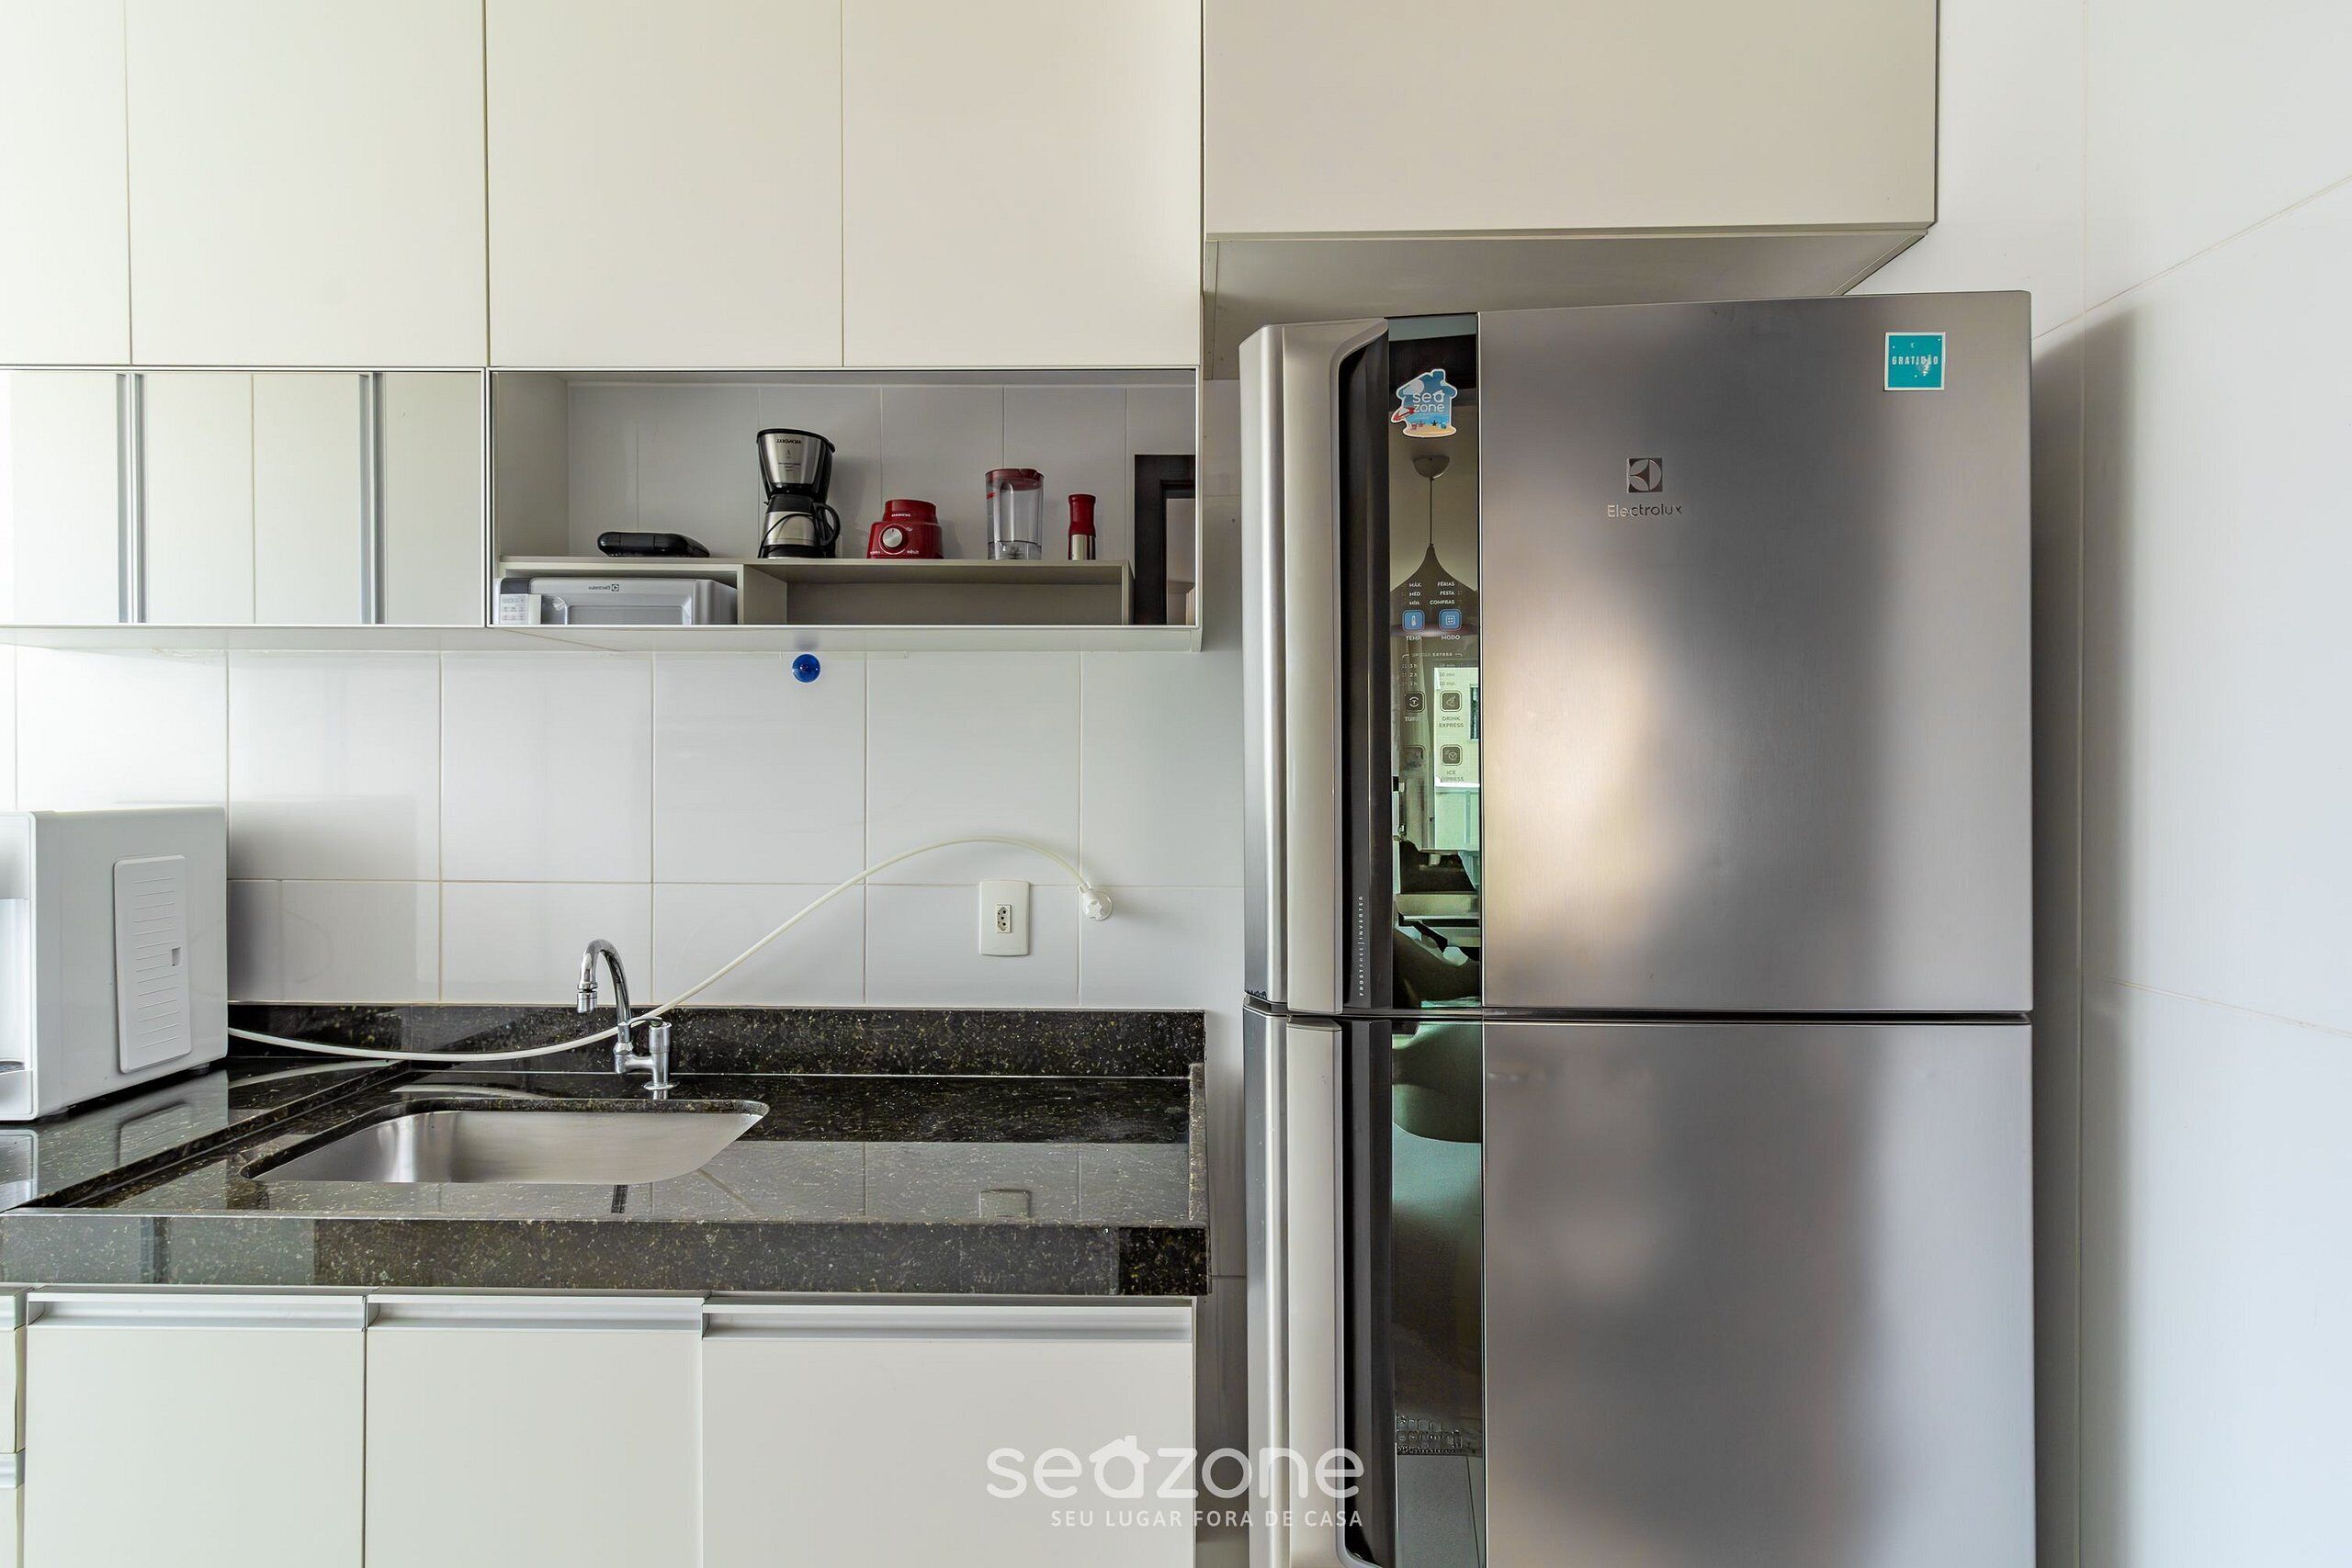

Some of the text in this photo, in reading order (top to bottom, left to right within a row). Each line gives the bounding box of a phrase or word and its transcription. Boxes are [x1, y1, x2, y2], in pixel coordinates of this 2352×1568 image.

[1412, 389, 1445, 403] sea
[1412, 403, 1445, 413] zone
[1606, 502, 1683, 518] Electrolux
